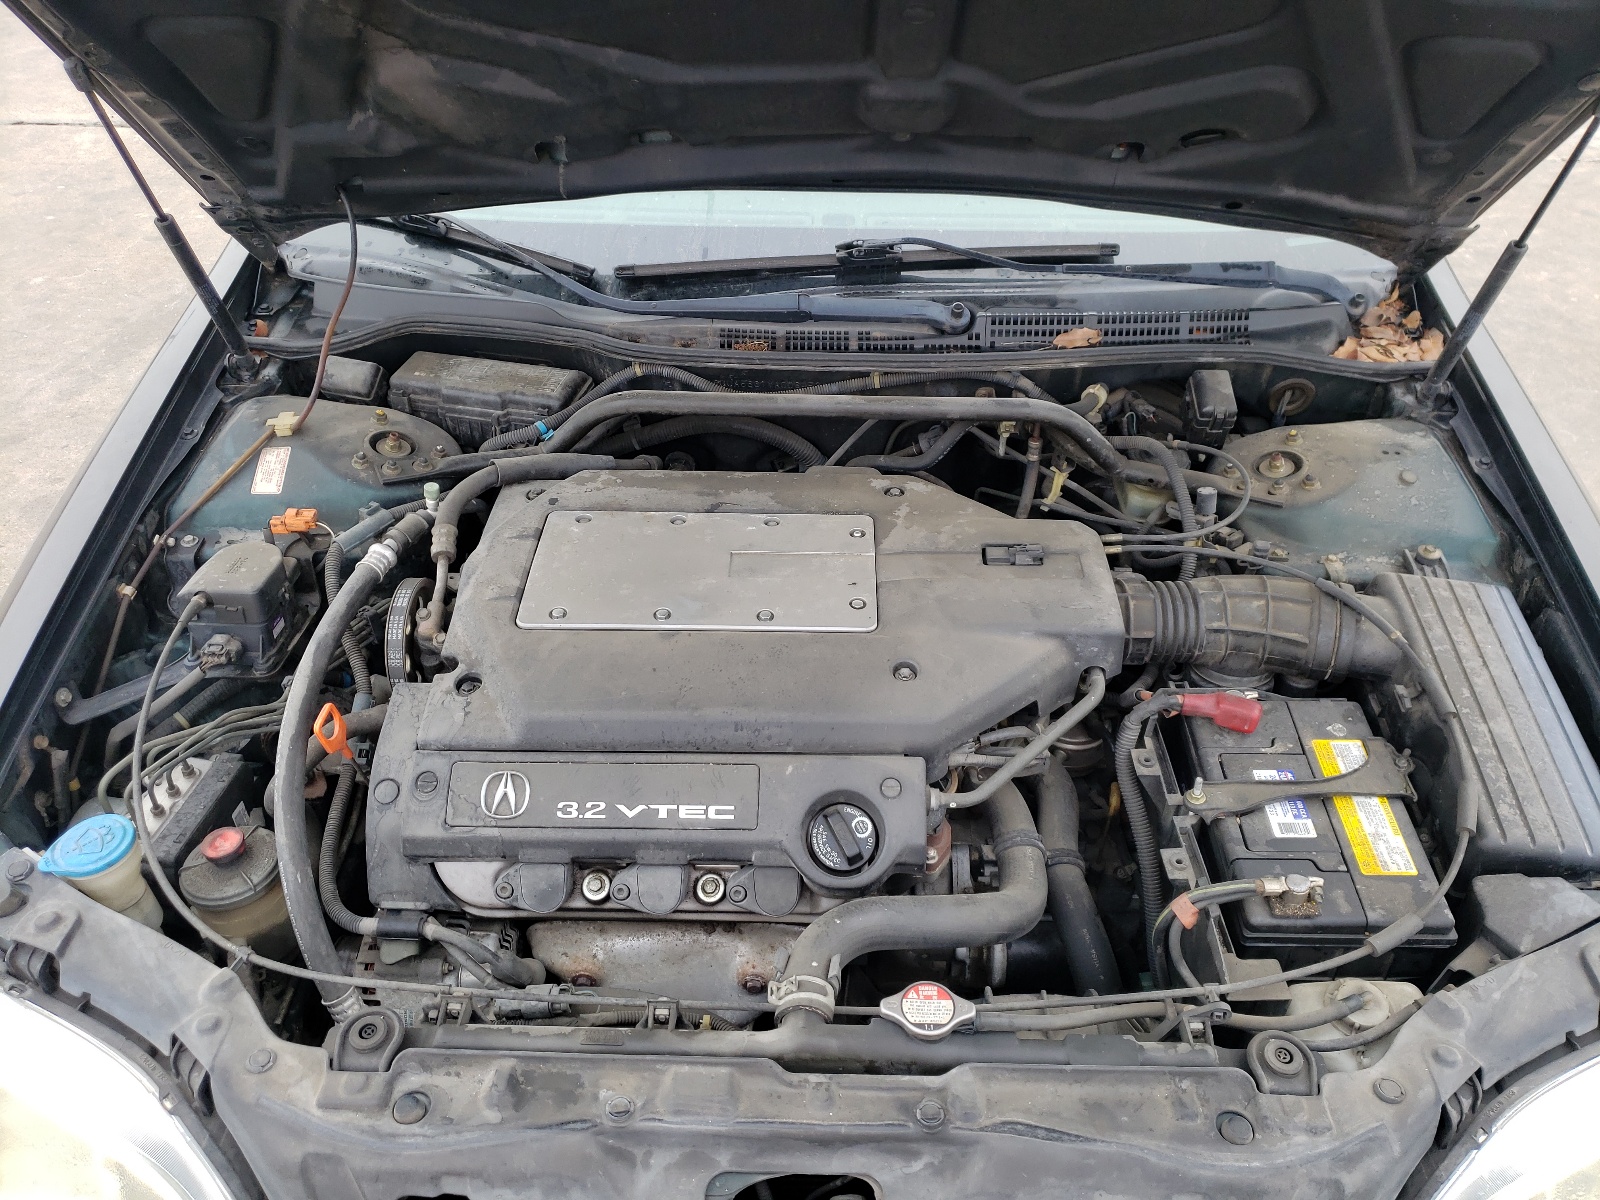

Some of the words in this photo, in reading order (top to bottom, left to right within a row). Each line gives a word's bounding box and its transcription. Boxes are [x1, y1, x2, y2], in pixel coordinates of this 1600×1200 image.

[556, 802, 606, 818] 3.2
[614, 804, 735, 820] VTEC
[844, 806, 862, 817] ENGINE
